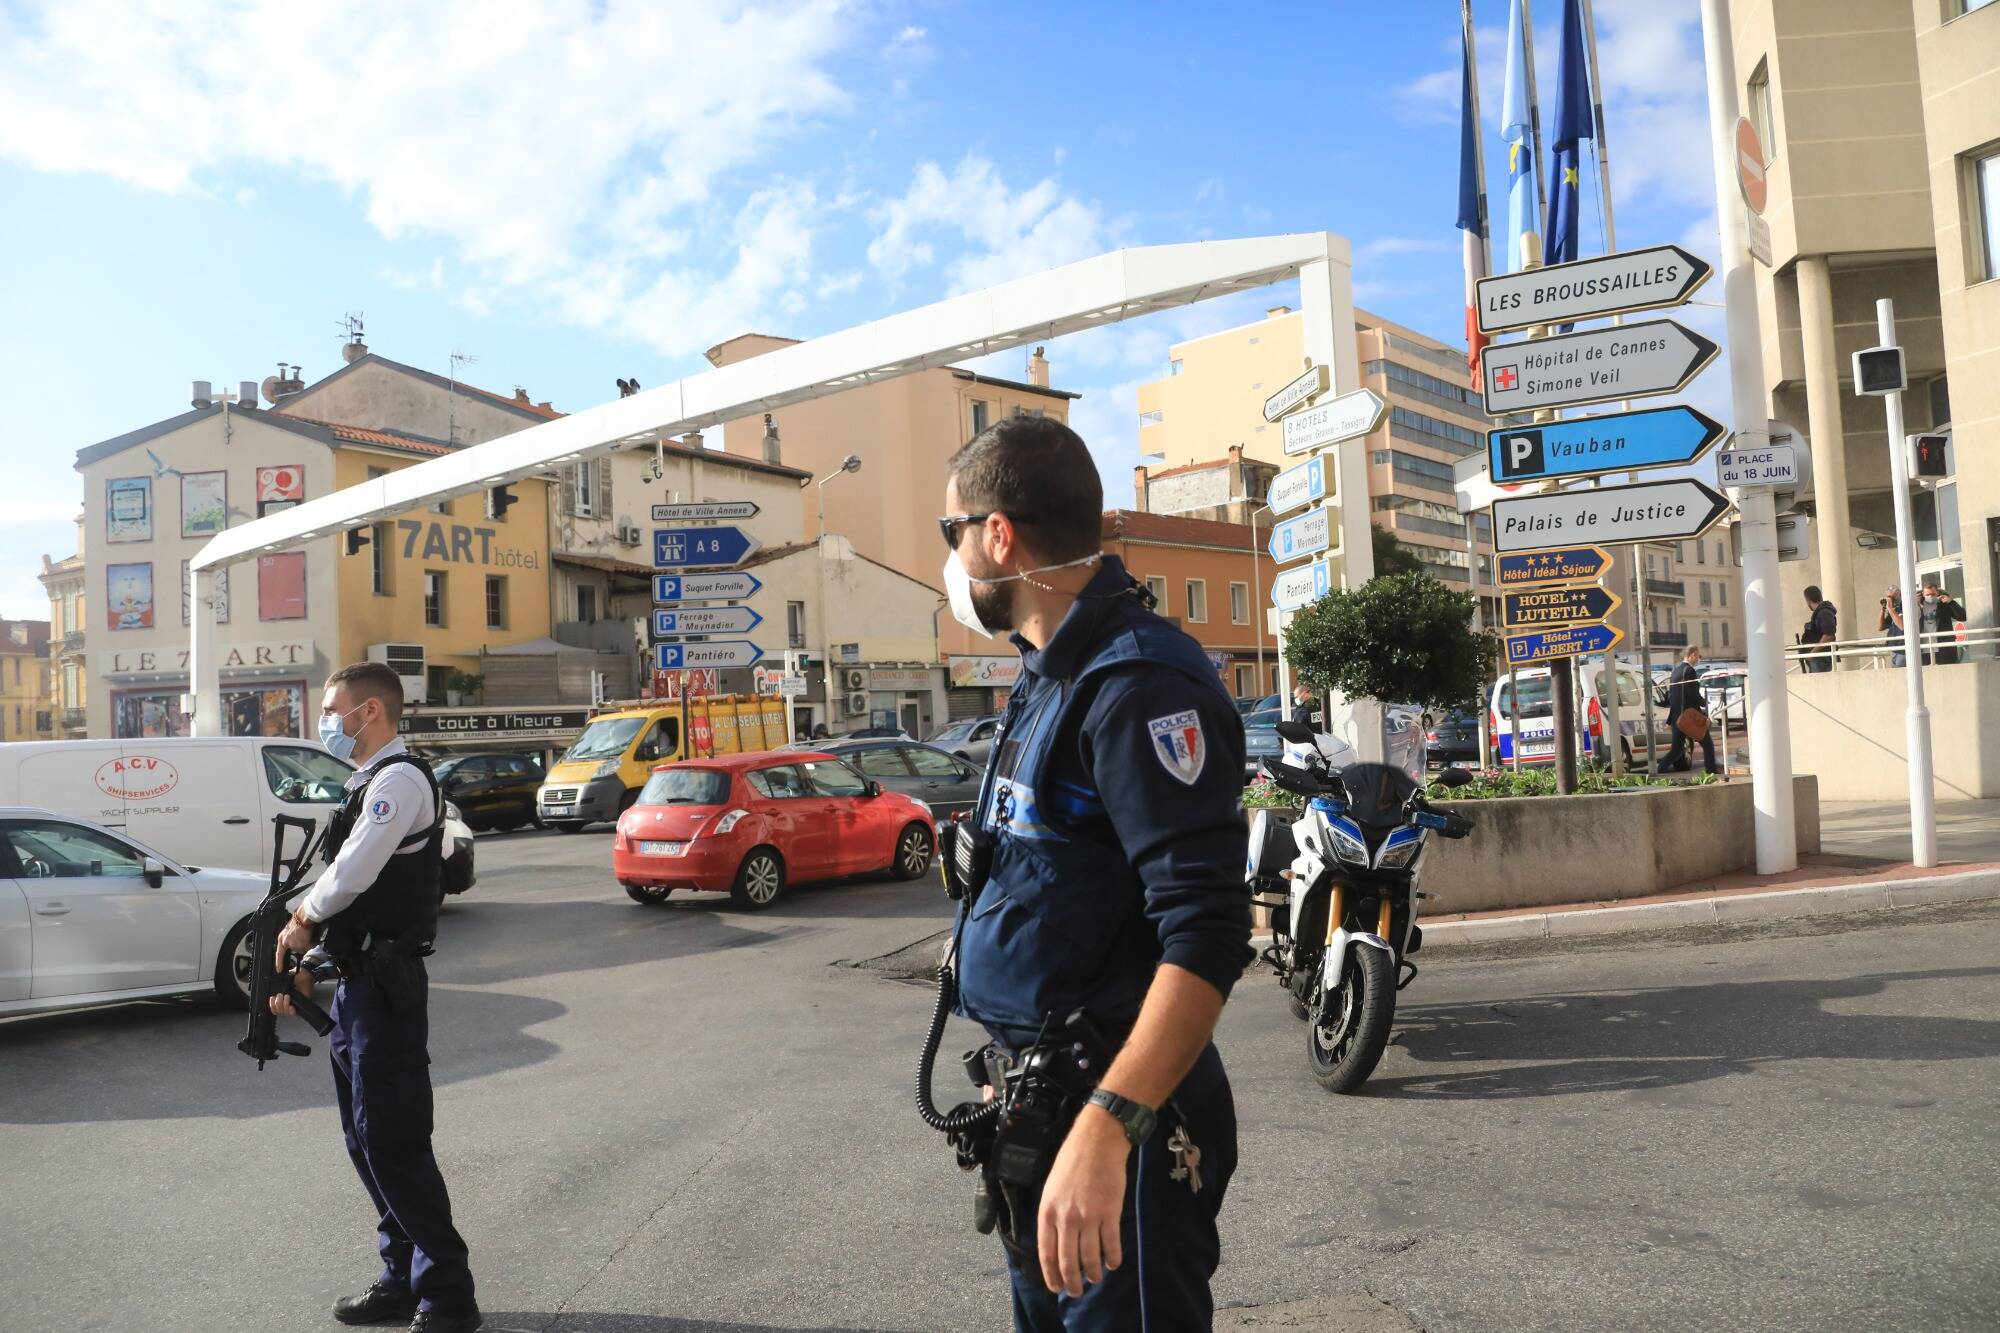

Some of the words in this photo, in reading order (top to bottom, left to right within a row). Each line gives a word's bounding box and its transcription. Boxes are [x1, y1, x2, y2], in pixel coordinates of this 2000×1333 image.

[1489, 292, 1521, 312] LES
[1533, 265, 1678, 305] BROUSSAILLES
[1524, 347, 1578, 370] Hôpital
[1585, 346, 1603, 361] de
[1610, 338, 1667, 357] Cannes
[1526, 376, 1583, 395] Simone
[1589, 368, 1621, 385] Veil
[1296, 410, 1328, 431] HOTELS
[1340, 417, 1366, 433] Tassigny
[1509, 437, 1533, 469] P
[1551, 436, 1626, 458] Vauban
[1738, 453, 1774, 464] PLACE
[1310, 466, 1319, 491] P
[1723, 471, 1739, 481] du
[1743, 468, 1758, 479] 18
[1762, 466, 1791, 478] JUIN
[657, 507, 679, 517] Hôtel
[682, 507, 692, 516] de
[695, 506, 714, 515] Ville
[717, 506, 747, 515] Annexe
[1505, 512, 1563, 534] Palais
[1575, 510, 1598, 527] de
[1610, 502, 1686, 523] Justice
[398, 519, 496, 564] 7ART
[494, 547, 539, 569] hôtel
[696, 540, 705, 552] A
[711, 540, 720, 552] 8
[1503, 567, 1531, 581] Hôtel
[1533, 566, 1559, 578] Idéal
[1561, 564, 1596, 577] Séjour
[664, 581, 676, 596] P
[684, 584, 713, 593] Suquet
[714, 582, 744, 591] Forville
[1287, 577, 1313, 599] Pantiéro
[1317, 570, 1324, 594] P
[1519, 593, 1569, 607] HOTEL
[662, 616, 673, 629] P
[679, 613, 714, 622] Ferrage
[1516, 605, 1591, 622] LUTETIA
[685, 622, 734, 631] Meynadier
[1542, 631, 1572, 644] Hôtel
[666, 649, 678, 665] P
[687, 650, 735, 660] Pantiéro
[1532, 640, 1584, 658] ALBERT
[112, 652, 156, 672] LE
[226, 645, 303, 666] ART
[757, 676, 779, 694] CHIC
[436, 717, 478, 730] tout
[487, 716, 497, 728] à
[504, 715, 563, 728] l'heure
[1151, 712, 1197, 731] POLICE
[1634, 720, 1664, 734] POCE
[689, 727, 714, 740] STOP
[1523, 729, 1553, 738] POLIC
[114, 758, 158, 773] A.C.V
[107, 783, 170, 797] SHIPSERVICES
[100, 808, 131, 816] YACHT
[133, 806, 180, 815] SUPPLIER
